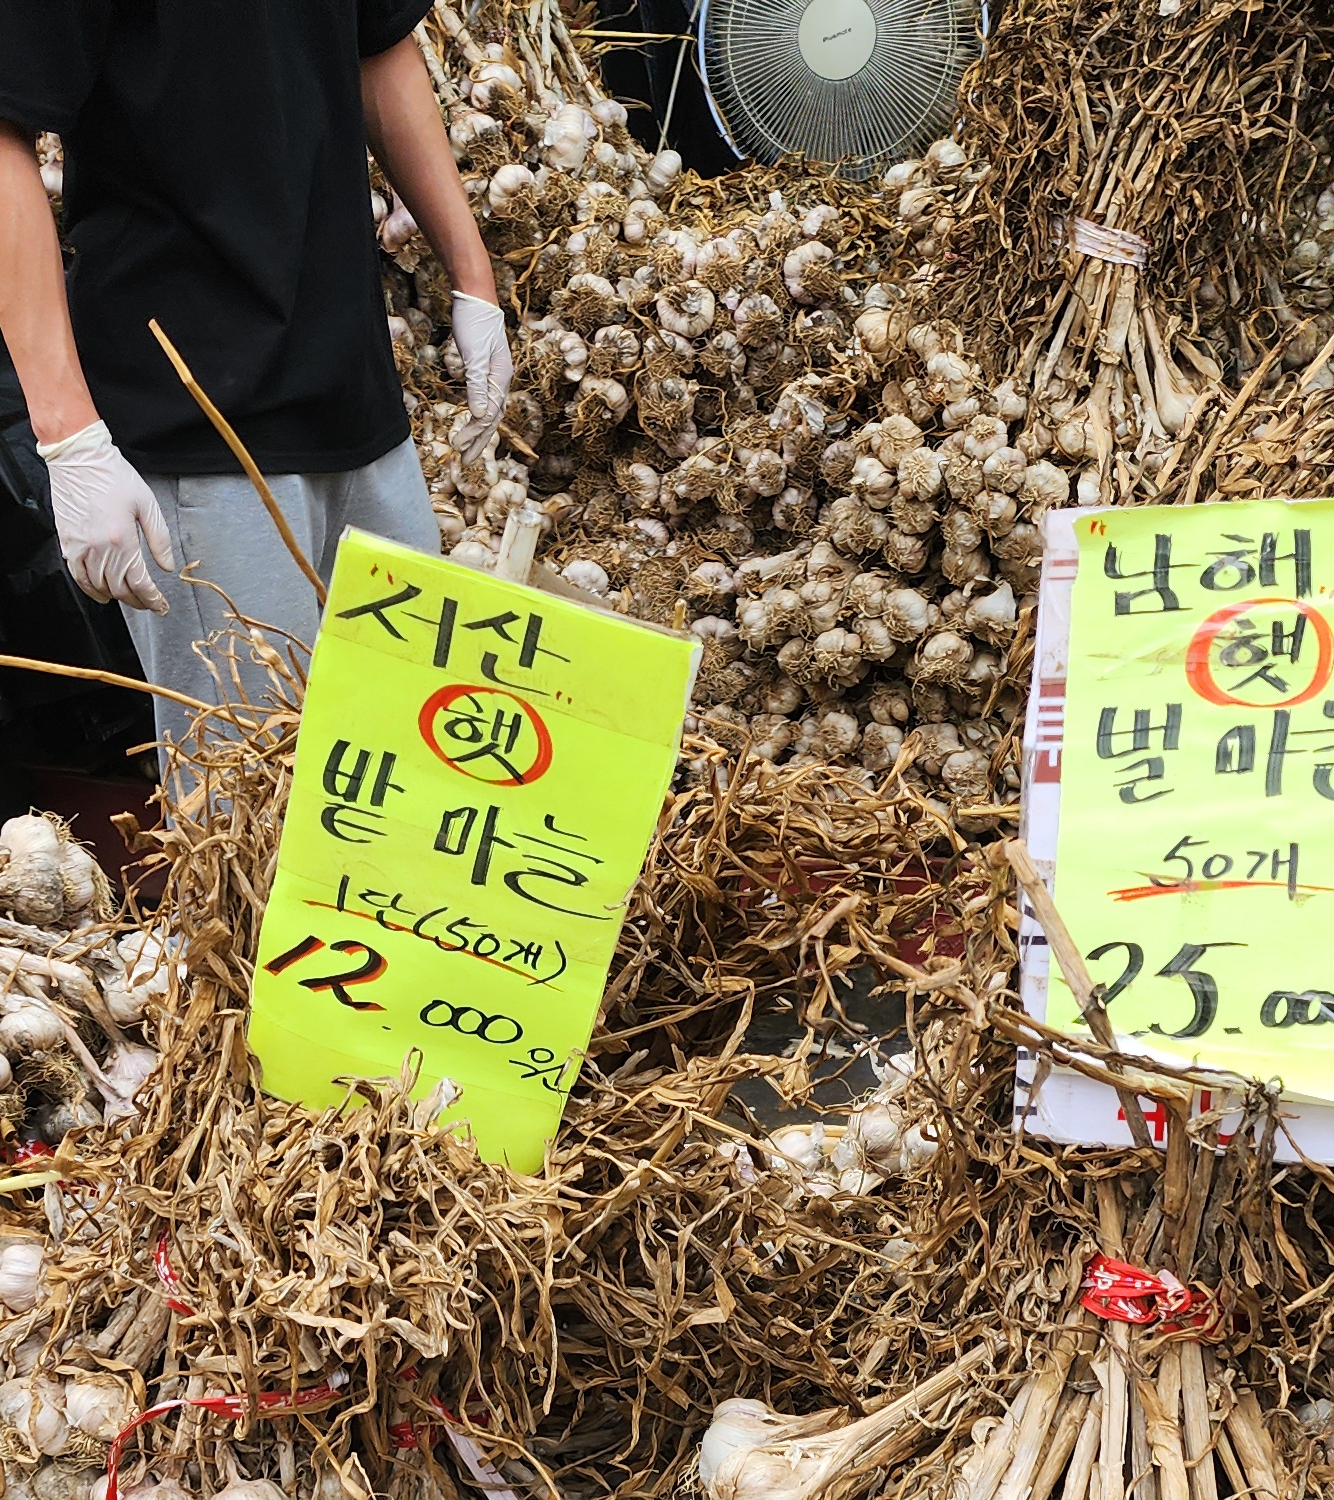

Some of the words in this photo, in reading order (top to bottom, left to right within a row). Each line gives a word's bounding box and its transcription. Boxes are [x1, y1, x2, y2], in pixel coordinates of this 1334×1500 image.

[1219, 613, 1307, 693] 햇
[442, 694, 524, 785] 햇
[1149, 836, 1300, 899] 50개
